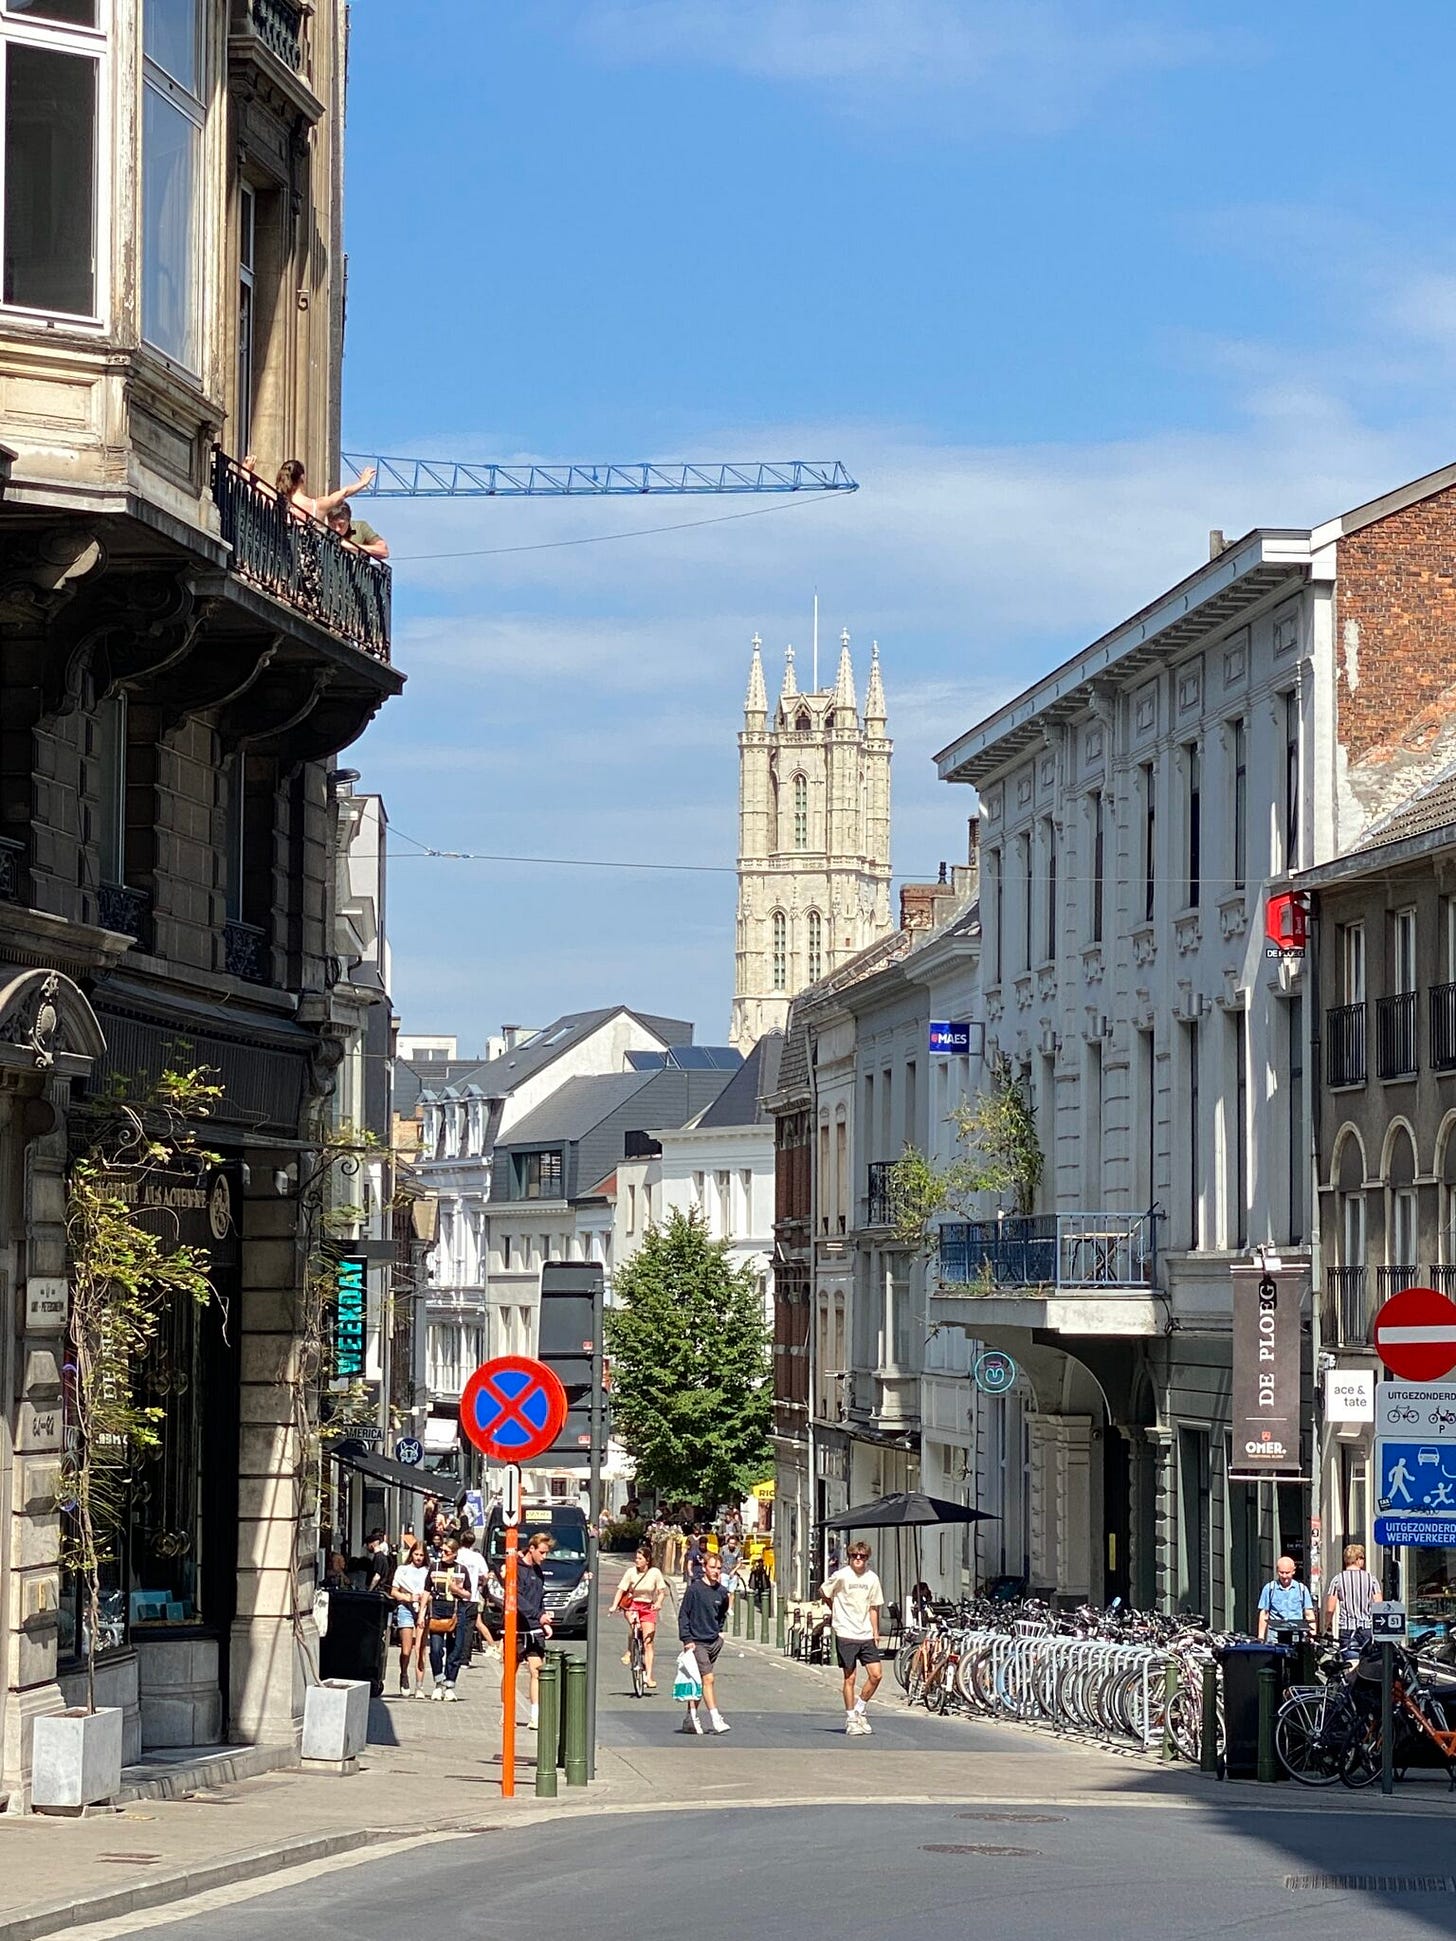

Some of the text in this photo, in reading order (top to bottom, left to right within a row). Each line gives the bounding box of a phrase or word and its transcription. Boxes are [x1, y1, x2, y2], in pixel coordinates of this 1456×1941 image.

[938, 1033, 967, 1044] MAES
[338, 1261, 363, 1375] WEEKDAY
[1259, 1284, 1275, 1407] DE PLOEG
[1334, 1385, 1366, 1395] ace &
[1388, 1391, 1456, 1401] UITGEZONDERD
[1344, 1397, 1367, 1407] tate
[345, 1427, 383, 1438] AMERICA
[1439, 1424, 1446, 1434] P
[1386, 1522, 1456, 1533] UITGEZONDERD
[1386, 1532, 1456, 1543] WERFVERKEER
